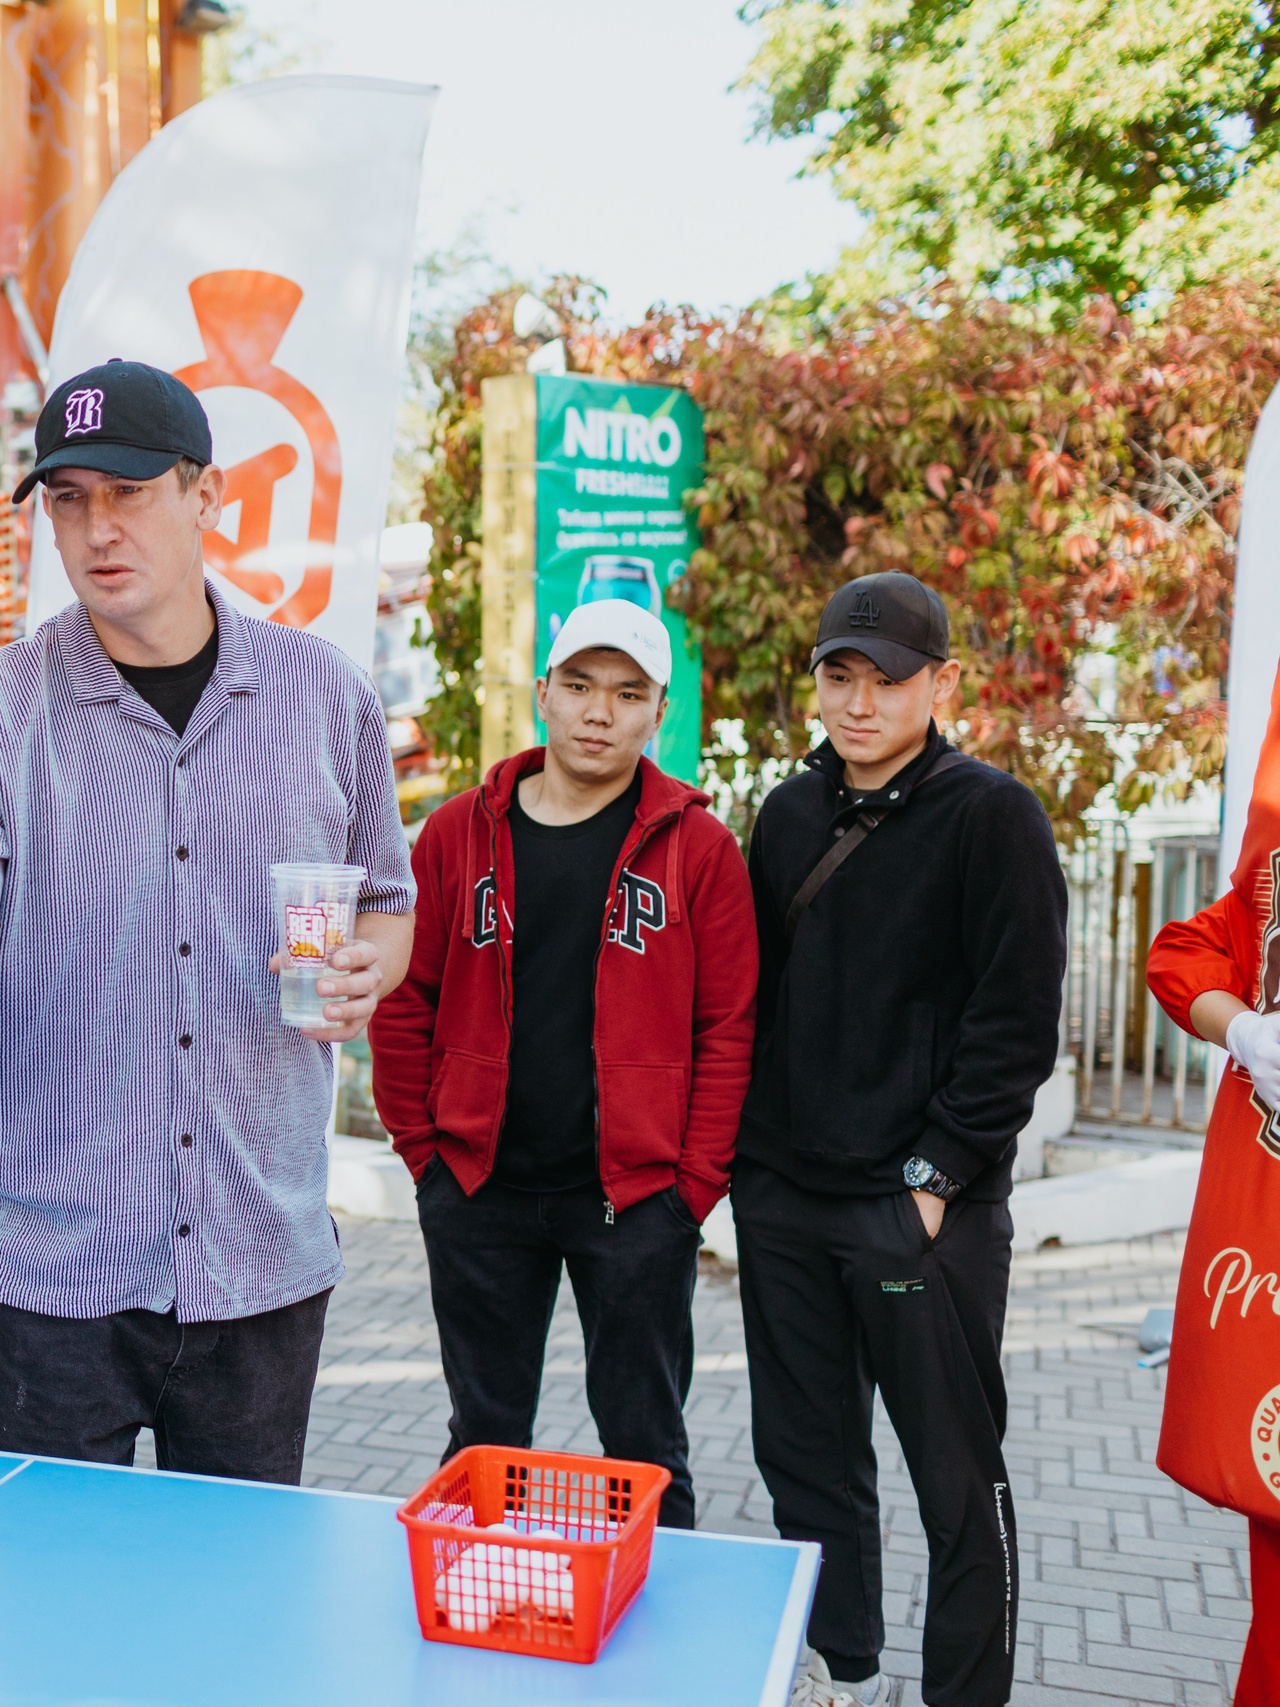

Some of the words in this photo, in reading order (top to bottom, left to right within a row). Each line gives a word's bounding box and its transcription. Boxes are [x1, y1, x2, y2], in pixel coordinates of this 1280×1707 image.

[563, 406, 682, 467] NITRO
[849, 590, 881, 628] LA
[289, 914, 325, 936] RED
[472, 870, 666, 955] GP
[288, 935, 326, 957] SUN
